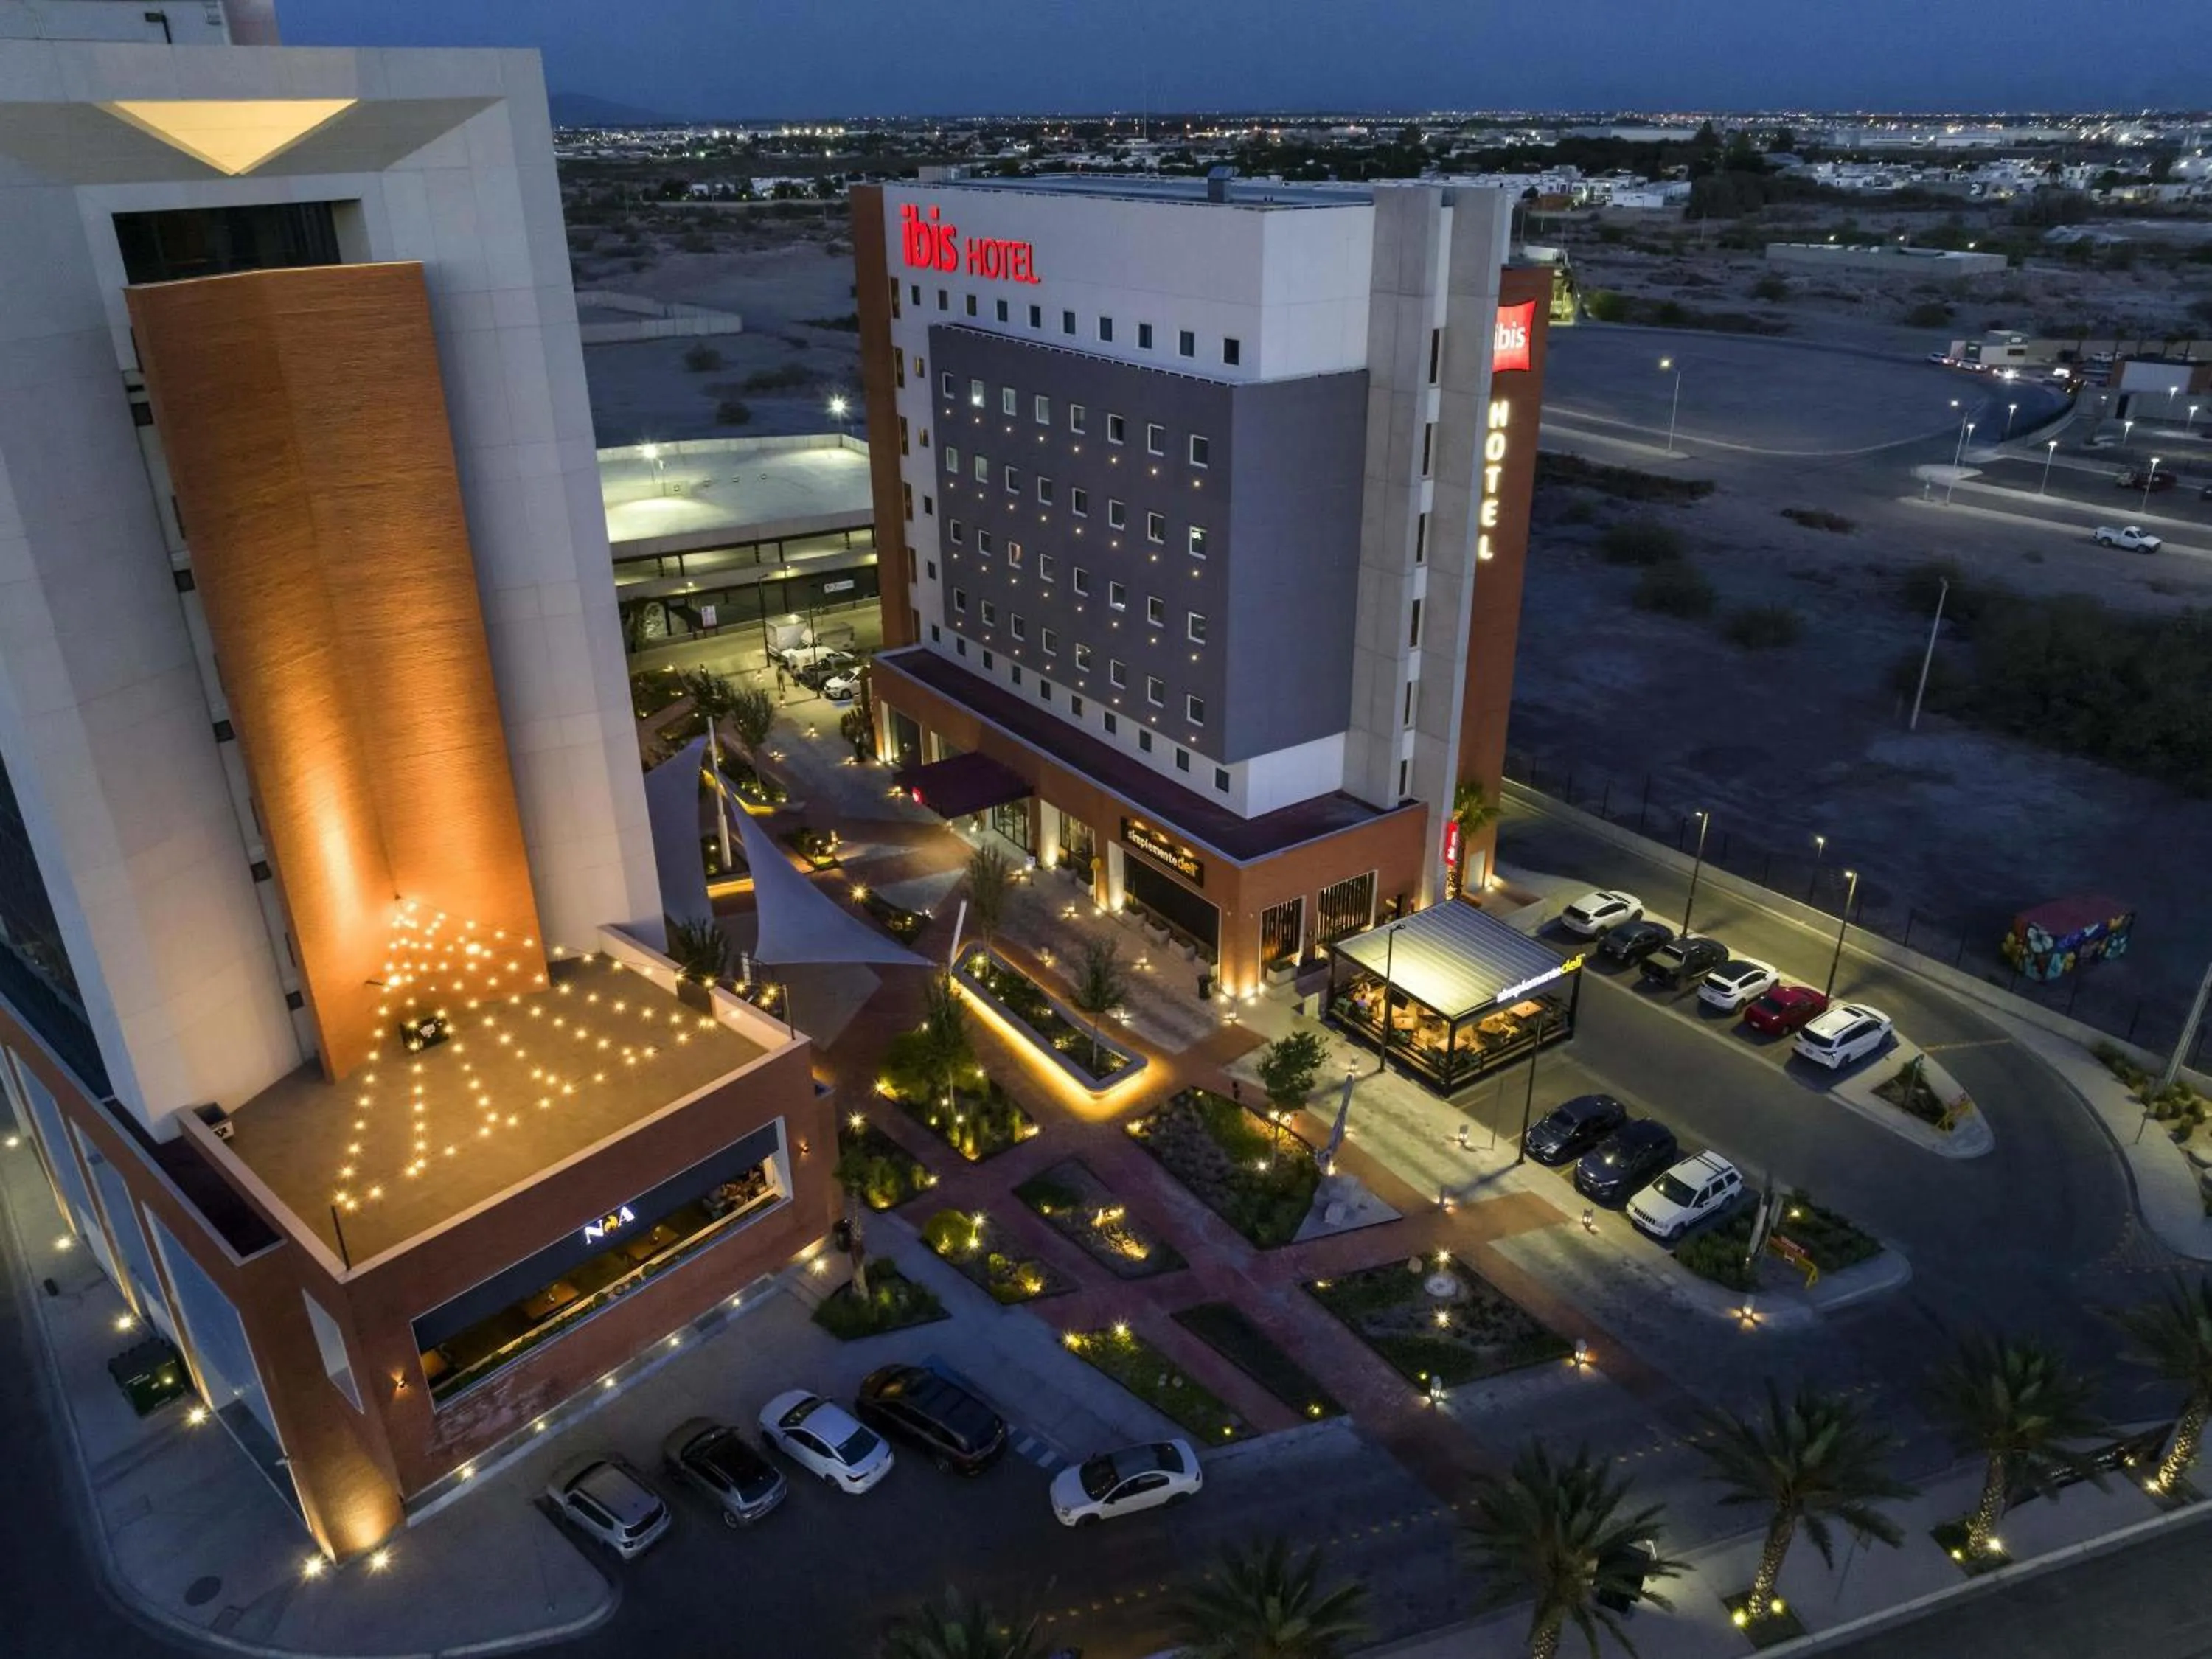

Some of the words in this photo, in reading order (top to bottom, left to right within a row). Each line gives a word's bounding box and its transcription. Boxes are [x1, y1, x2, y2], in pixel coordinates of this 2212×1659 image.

[900, 204, 958, 272] ibis
[966, 236, 1040, 283] HOTEL
[1478, 399, 1510, 560] HOTEL
